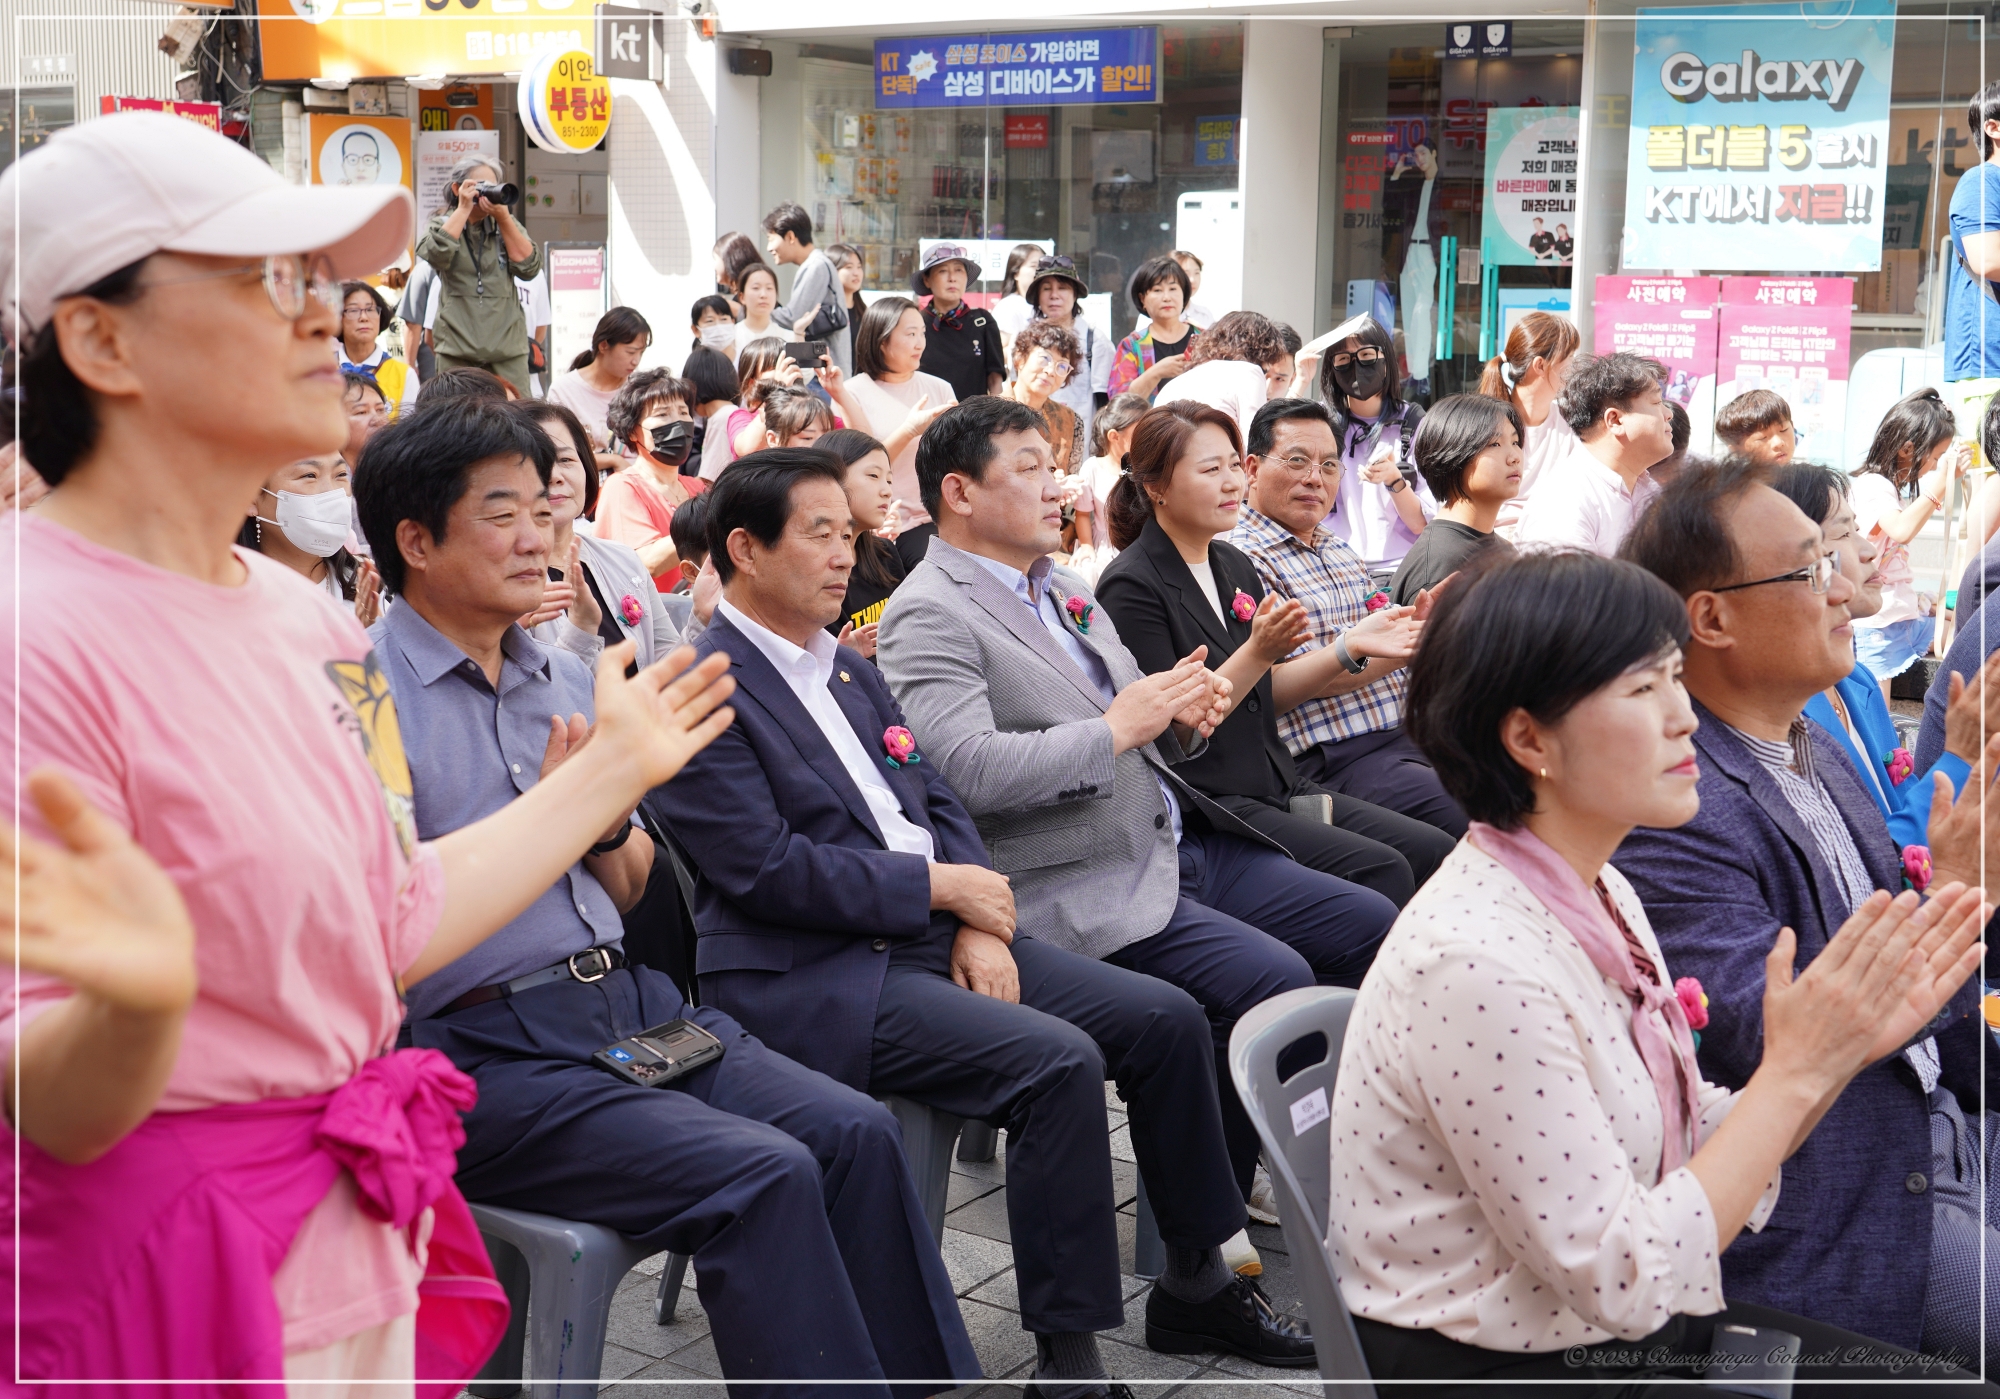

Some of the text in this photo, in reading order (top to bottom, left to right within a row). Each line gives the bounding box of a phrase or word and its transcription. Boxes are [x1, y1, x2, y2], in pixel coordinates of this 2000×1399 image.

[611, 22, 642, 62] kt
[945, 40, 1100, 65] 삼성 초이스 가입하면
[558, 59, 593, 81] 이안
[881, 52, 900, 72] KT
[881, 74, 918, 95] 단독!
[943, 65, 1151, 97] 삼성 디바이스가 할인!
[1660, 50, 1858, 107] Galaxy
[550, 87, 607, 121] 부동산
[562, 126, 599, 137] 851-2300
[1350, 134, 1366, 142] OTT
[1383, 134, 1394, 142] KT
[1646, 125, 1874, 168] 폴더블 5 출시
[1906, 127, 1968, 177] kt
[1521, 160, 1547, 174] 저희
[1496, 179, 1561, 193] 바른판매에
[1644, 184, 1869, 220] KT에서 지금!!
[1614, 333, 1626, 344] KT
[1615, 323, 1642, 333] Galaxy
[1648, 323, 1669, 332] Fold5
[1678, 324, 1696, 334] Flip5
[1741, 325, 1770, 335] Galaxy
[1777, 326, 1798, 335] Fold5
[1808, 327, 1827, 337] Flip5
[1654, 347, 1672, 358] OTT
